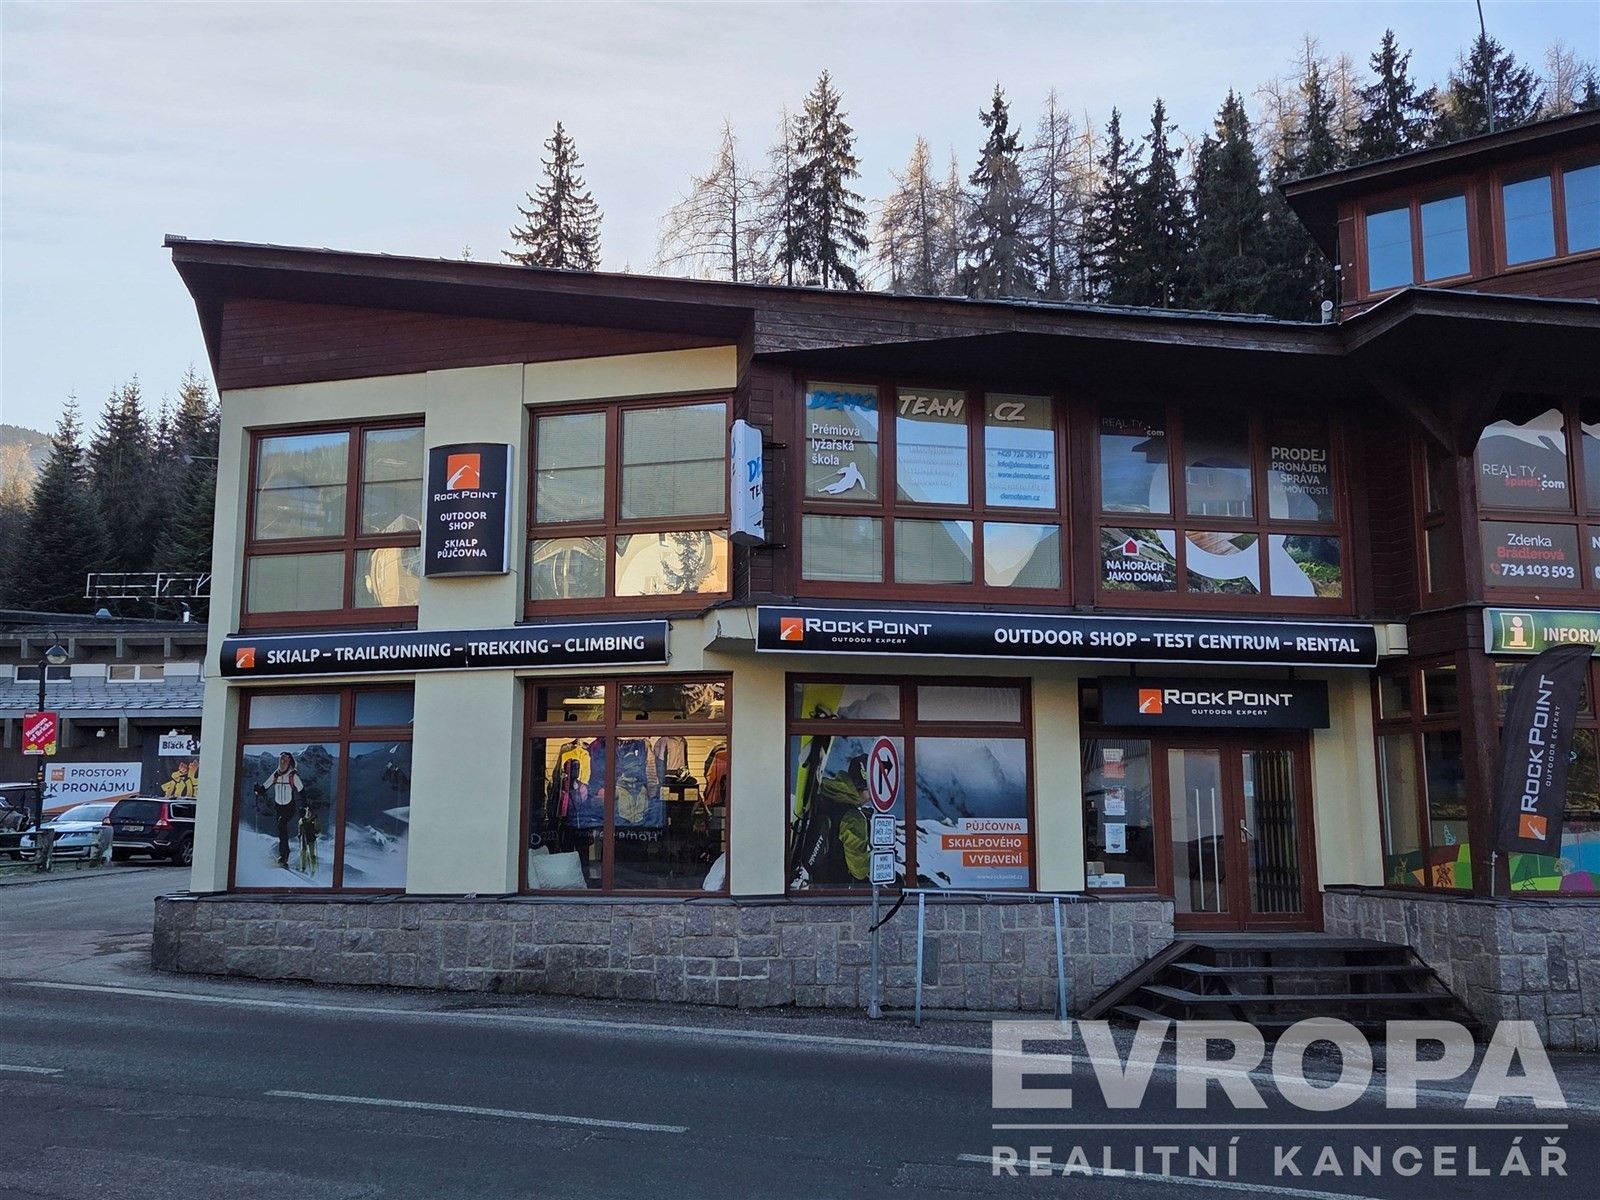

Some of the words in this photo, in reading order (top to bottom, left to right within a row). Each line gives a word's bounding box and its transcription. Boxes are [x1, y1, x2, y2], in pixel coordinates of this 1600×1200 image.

[898, 394, 965, 417] TEAM
[811, 438, 854, 452] lyžařská
[811, 453, 840, 466] škola
[1271, 446, 1326, 462] PRODEJ
[1272, 461, 1327, 474] PRONÁJEM
[1280, 472, 1320, 485] SPRÁVA
[440, 511, 487, 521] OUTDOOR
[448, 521, 475, 530] SHOP
[444, 538, 478, 548] SKIALP
[1507, 533, 1553, 547] Zdenka
[437, 547, 488, 559] PŮJČOVNA
[1106, 560, 1121, 570] NA
[1122, 559, 1165, 571] HORÁCH
[1501, 563, 1525, 577] 734
[1526, 565, 1550, 578] 103
[1551, 566, 1575, 579] 503
[1106, 571, 1133, 582] JAKO
[994, 627, 1084, 646] OUTDOOR
[1089, 630, 1138, 648] SHOP
[1153, 632, 1195, 649] TEST
[1198, 634, 1280, 651] CENTRUM
[1295, 636, 1361, 653] RENTAL
[266, 648, 320, 664] SKIALP
[334, 643, 451, 662] TRAILRUNNING
[467, 639, 549, 656] TREKKING
[564, 635, 645, 652] CLIMBING
[162, 741, 184, 750] Black
[1545, 741, 1556, 787] OUTDOOR
[1551, 704, 1561, 740] EXPERT
[71, 768, 129, 777] PROSTORY
[62, 779, 135, 792] PRONÁJMU
[965, 820, 1021, 831] PŮJČOVNA
[948, 837, 1022, 849] SKIALPOVÉHO
[969, 852, 1022, 865] VYBAVENÍ
